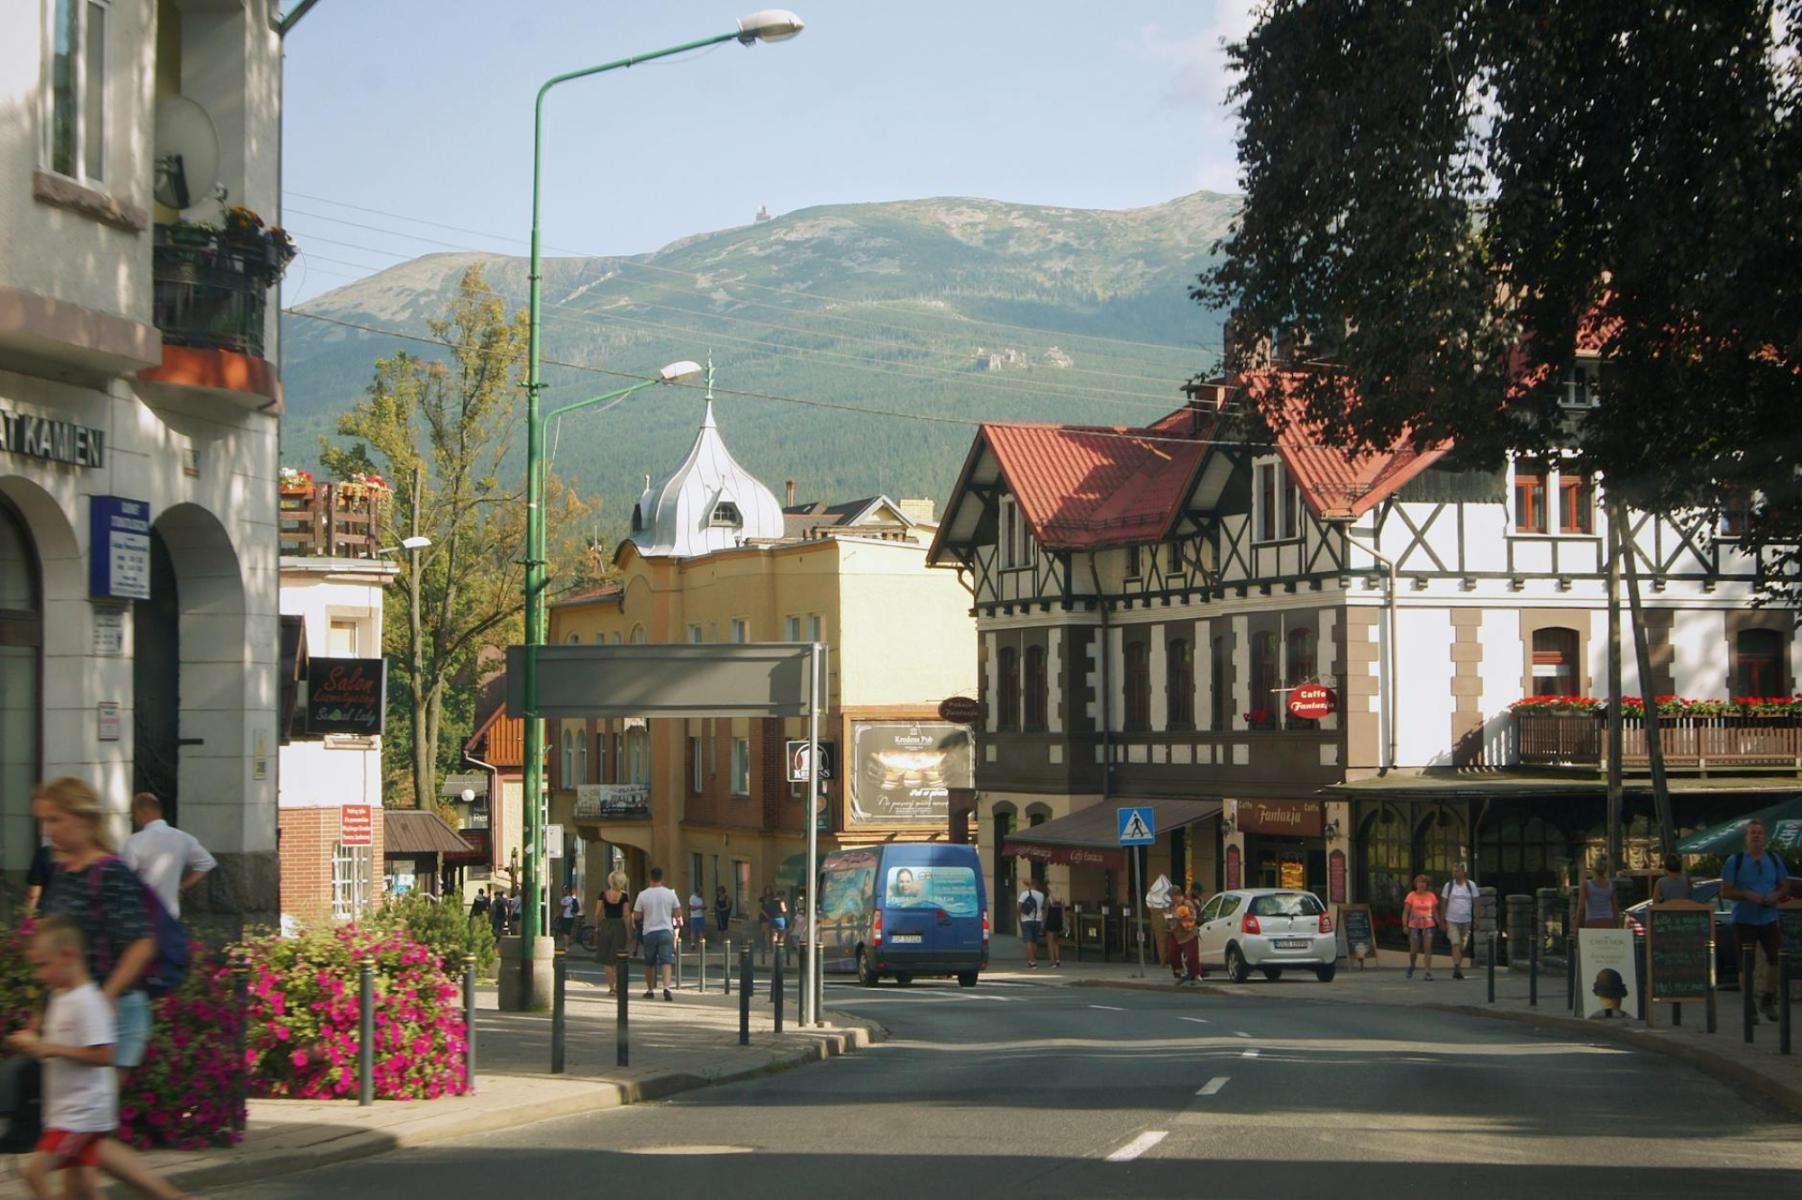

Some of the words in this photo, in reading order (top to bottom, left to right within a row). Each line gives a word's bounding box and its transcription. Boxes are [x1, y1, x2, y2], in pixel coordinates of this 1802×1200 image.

[323, 665, 375, 691] Salon
[1301, 690, 1326, 699] Caffe
[1257, 803, 1302, 826] Fantazja
